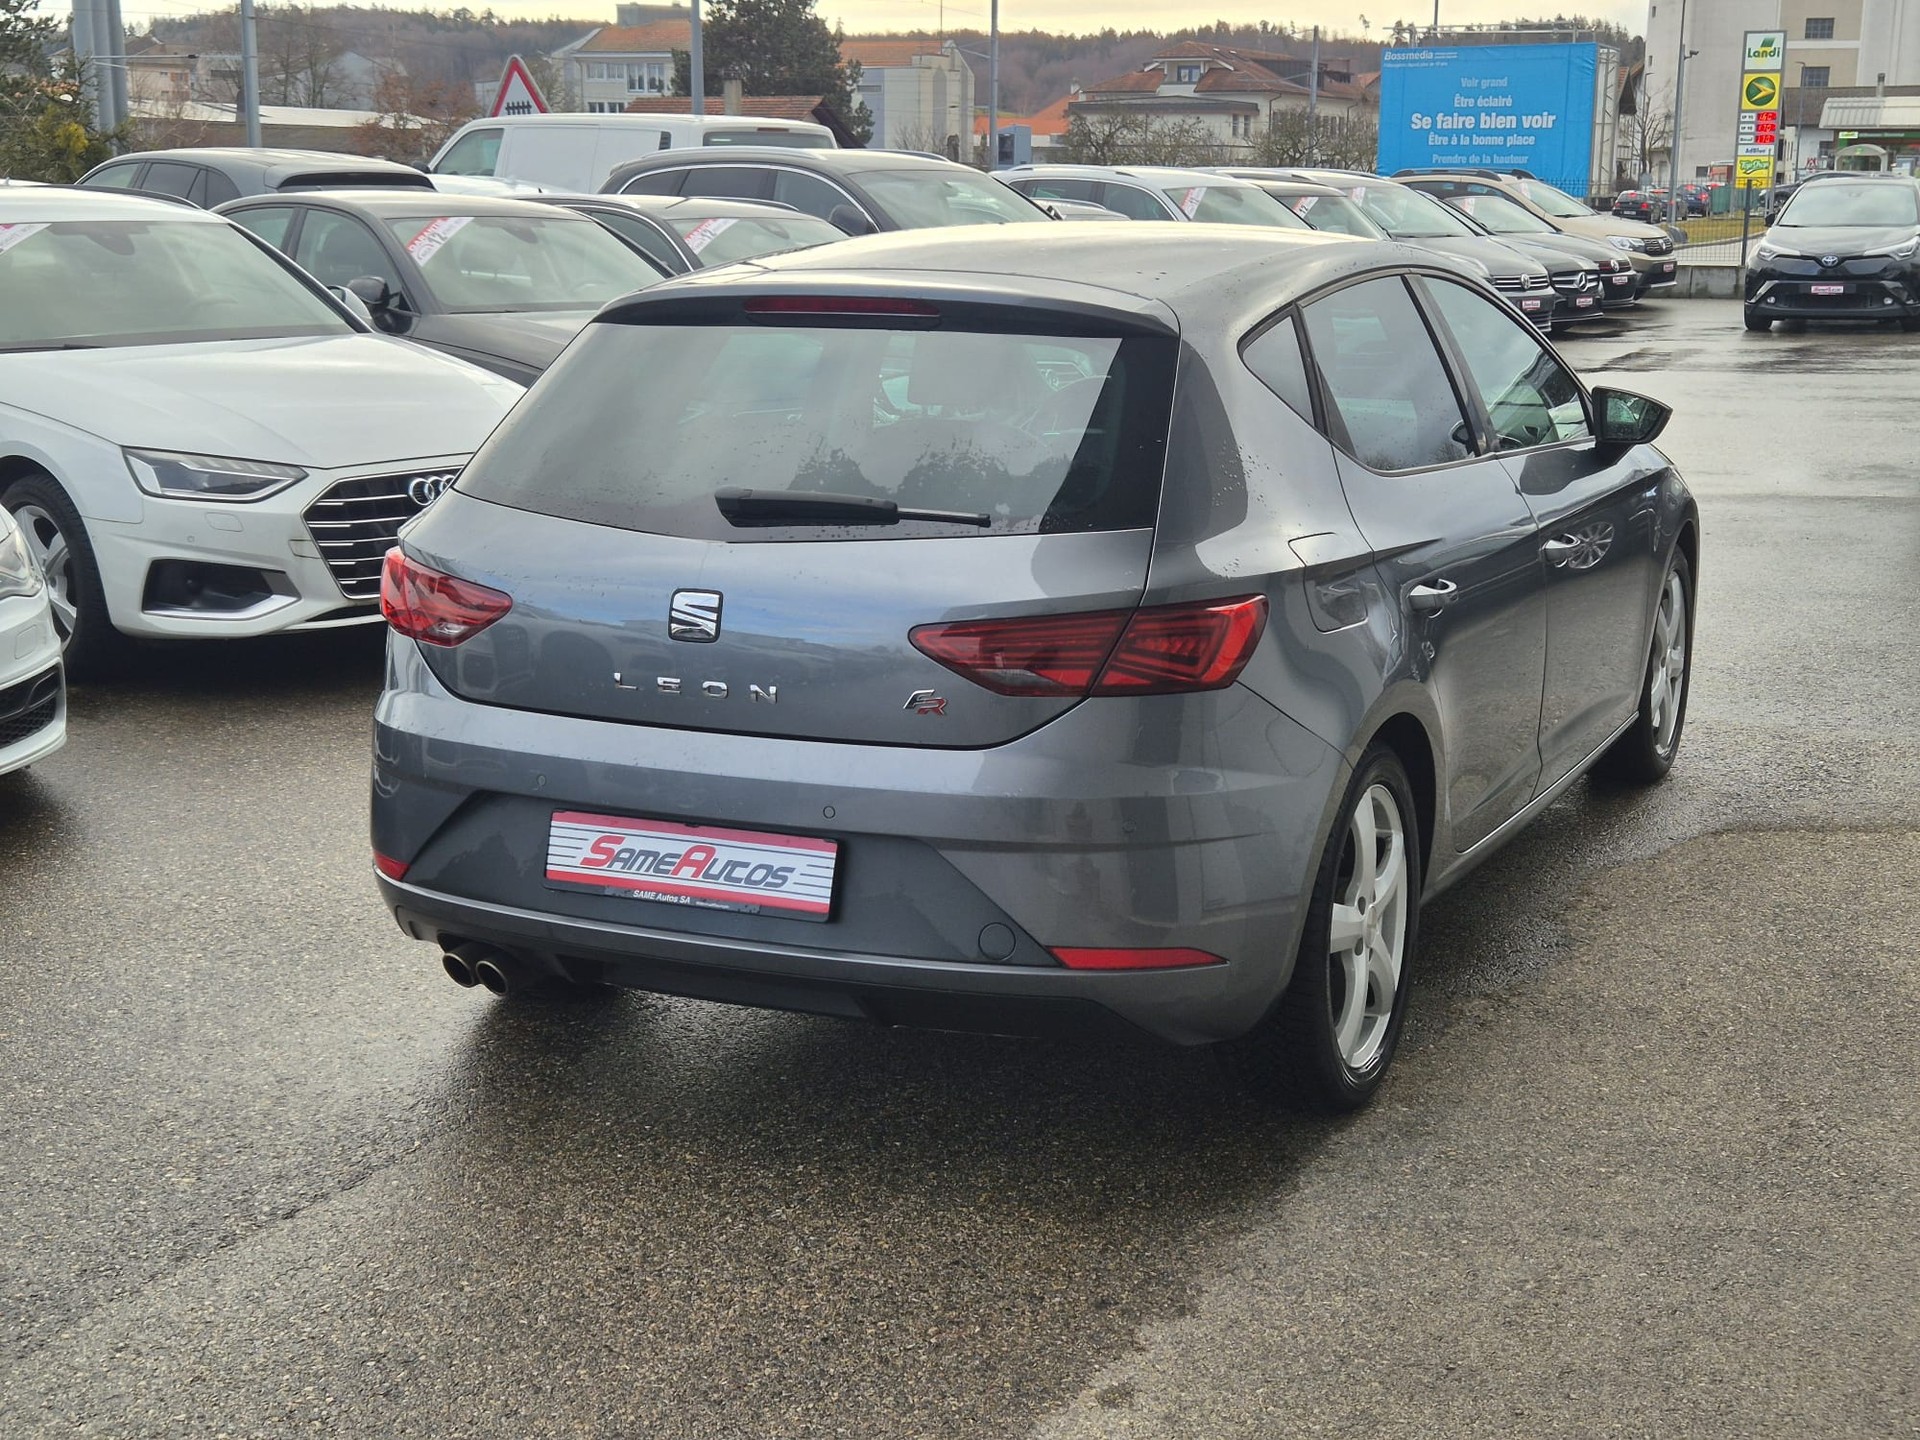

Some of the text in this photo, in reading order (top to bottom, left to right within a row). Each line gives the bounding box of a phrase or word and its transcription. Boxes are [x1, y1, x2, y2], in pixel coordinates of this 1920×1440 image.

[1384, 51, 1434, 60] Bossmedia
[1747, 47, 1781, 59] Landi
[1461, 76, 1508, 89] Voir grand
[1454, 93, 1513, 107] Être éclairé
[1411, 111, 1556, 129] Se faire bien voir
[1428, 131, 1536, 148] Être à la bonne place
[1432, 153, 1529, 164] Prendre de la hauteur
[428, 231, 448, 245] 12
[613, 671, 778, 704] LEON
[903, 689, 947, 716] FR
[633, 889, 691, 904] SAME Autos SA
